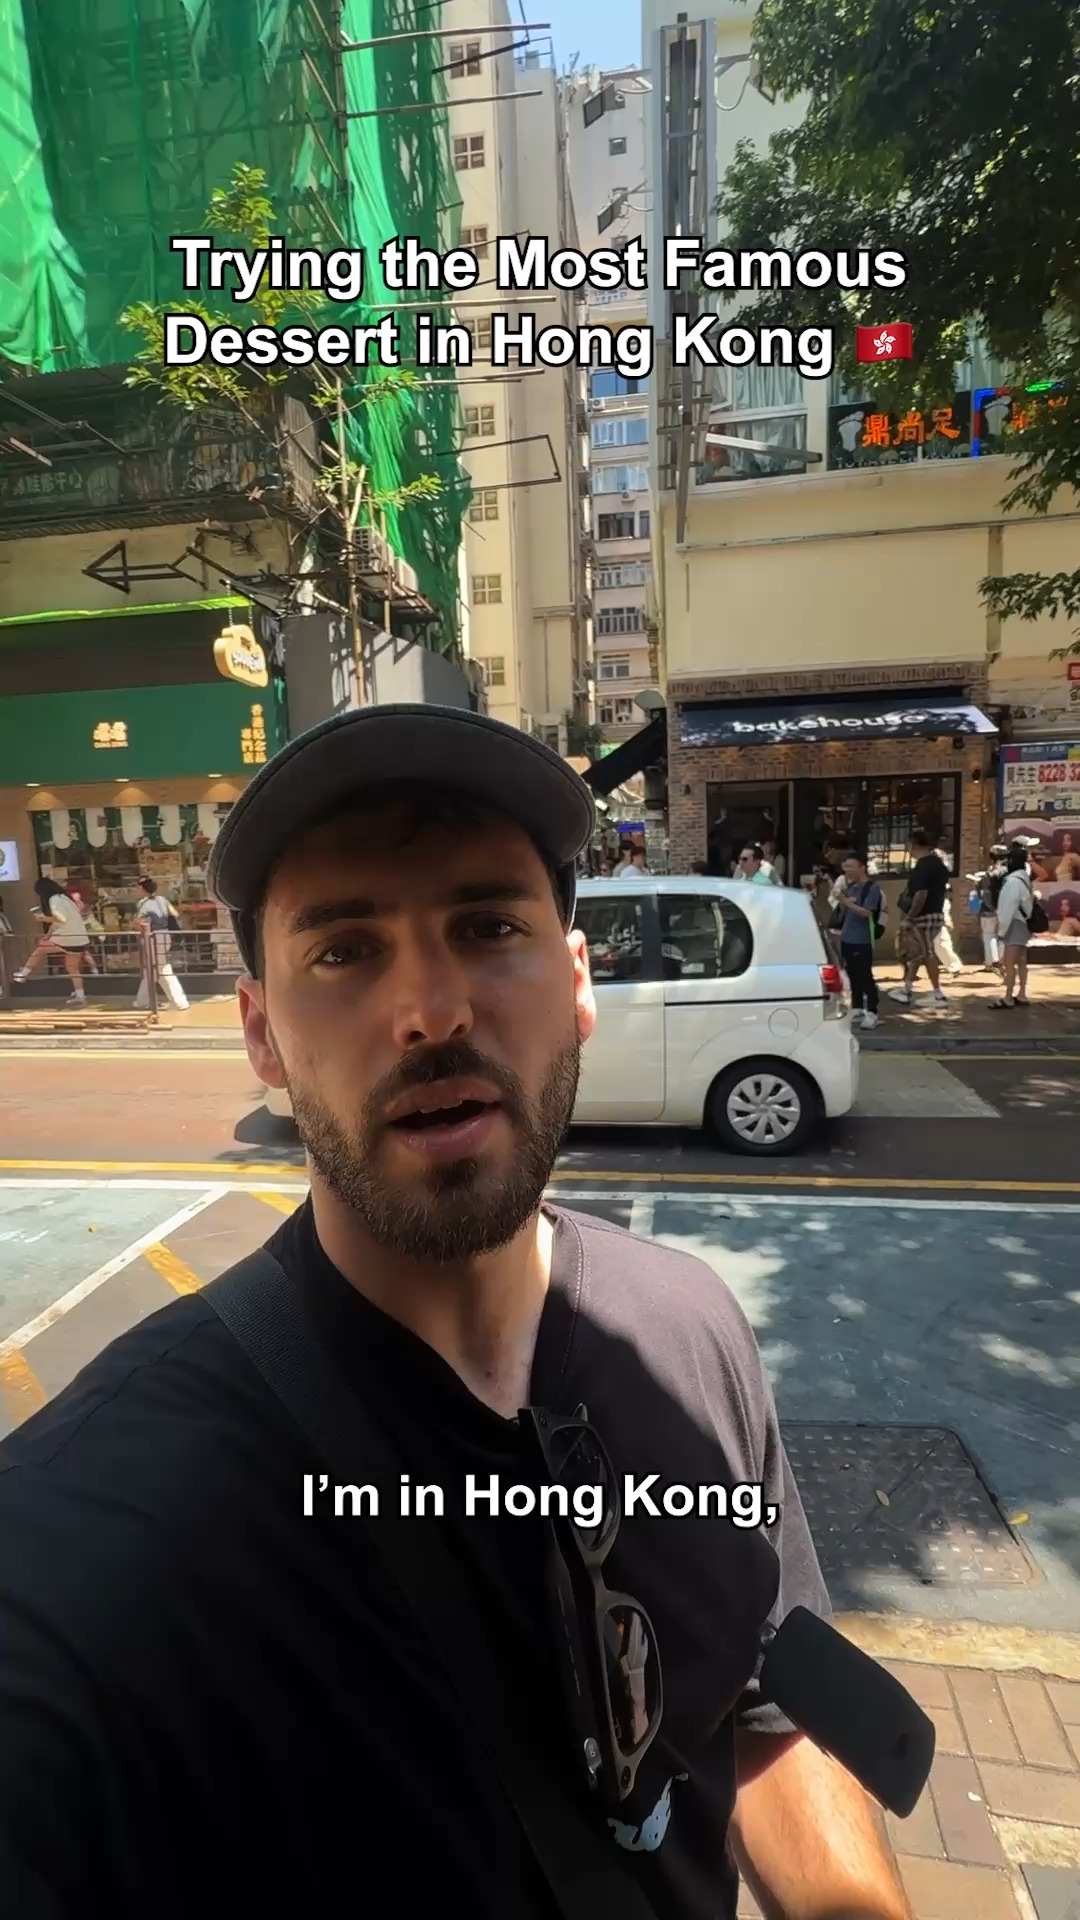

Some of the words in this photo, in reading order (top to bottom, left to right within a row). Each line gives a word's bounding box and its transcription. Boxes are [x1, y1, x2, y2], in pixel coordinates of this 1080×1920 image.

[862, 406, 961, 447] 鼎尚足
[732, 712, 927, 734] bakehouse
[1038, 763, 1067, 783] 8228
